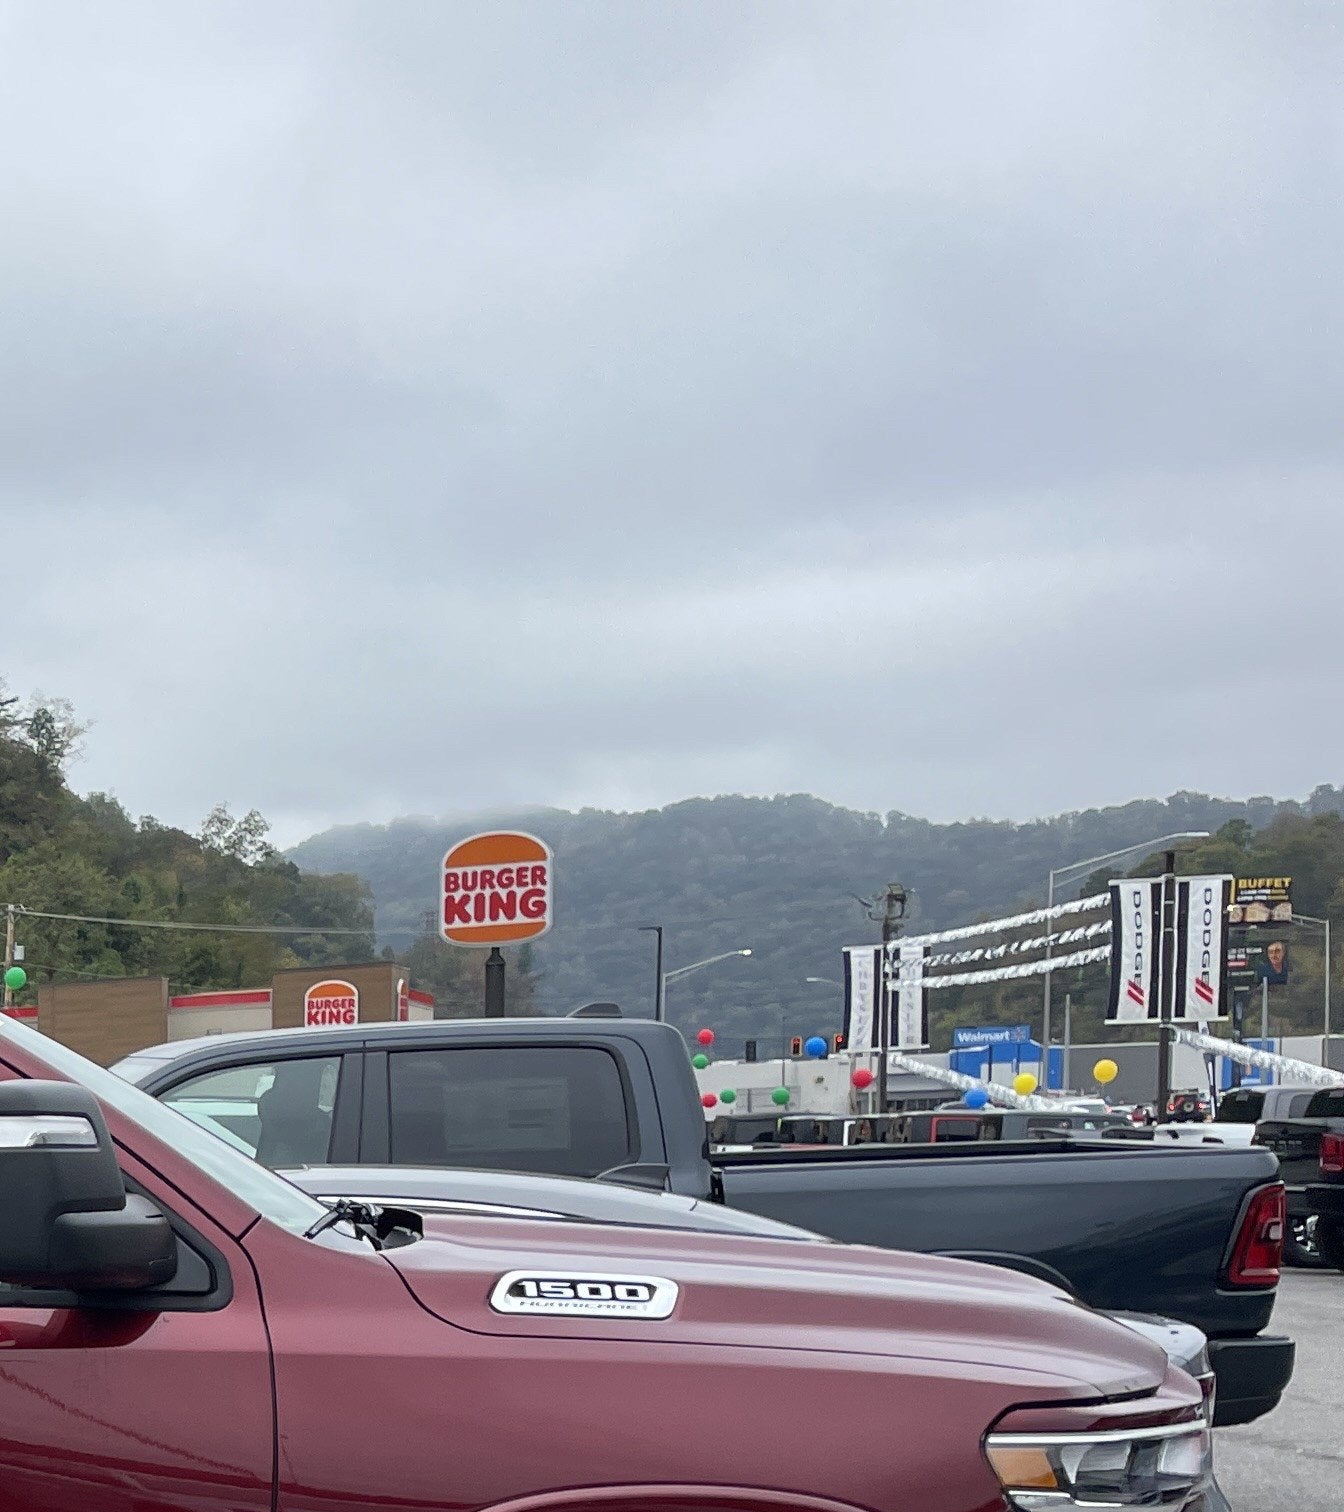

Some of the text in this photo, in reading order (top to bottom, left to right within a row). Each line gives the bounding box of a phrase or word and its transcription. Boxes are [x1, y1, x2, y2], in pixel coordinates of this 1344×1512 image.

[444, 864, 548, 893] BURGER
[444, 888, 548, 925] KING
[1133, 890, 1143, 987] DODGE
[1201, 887, 1212, 986] DODGE
[307, 998, 356, 1011] BURGER
[306, 1009, 356, 1027] KING
[957, 1031, 1011, 1042] Walmart
[517, 1279, 651, 1302] 1500
